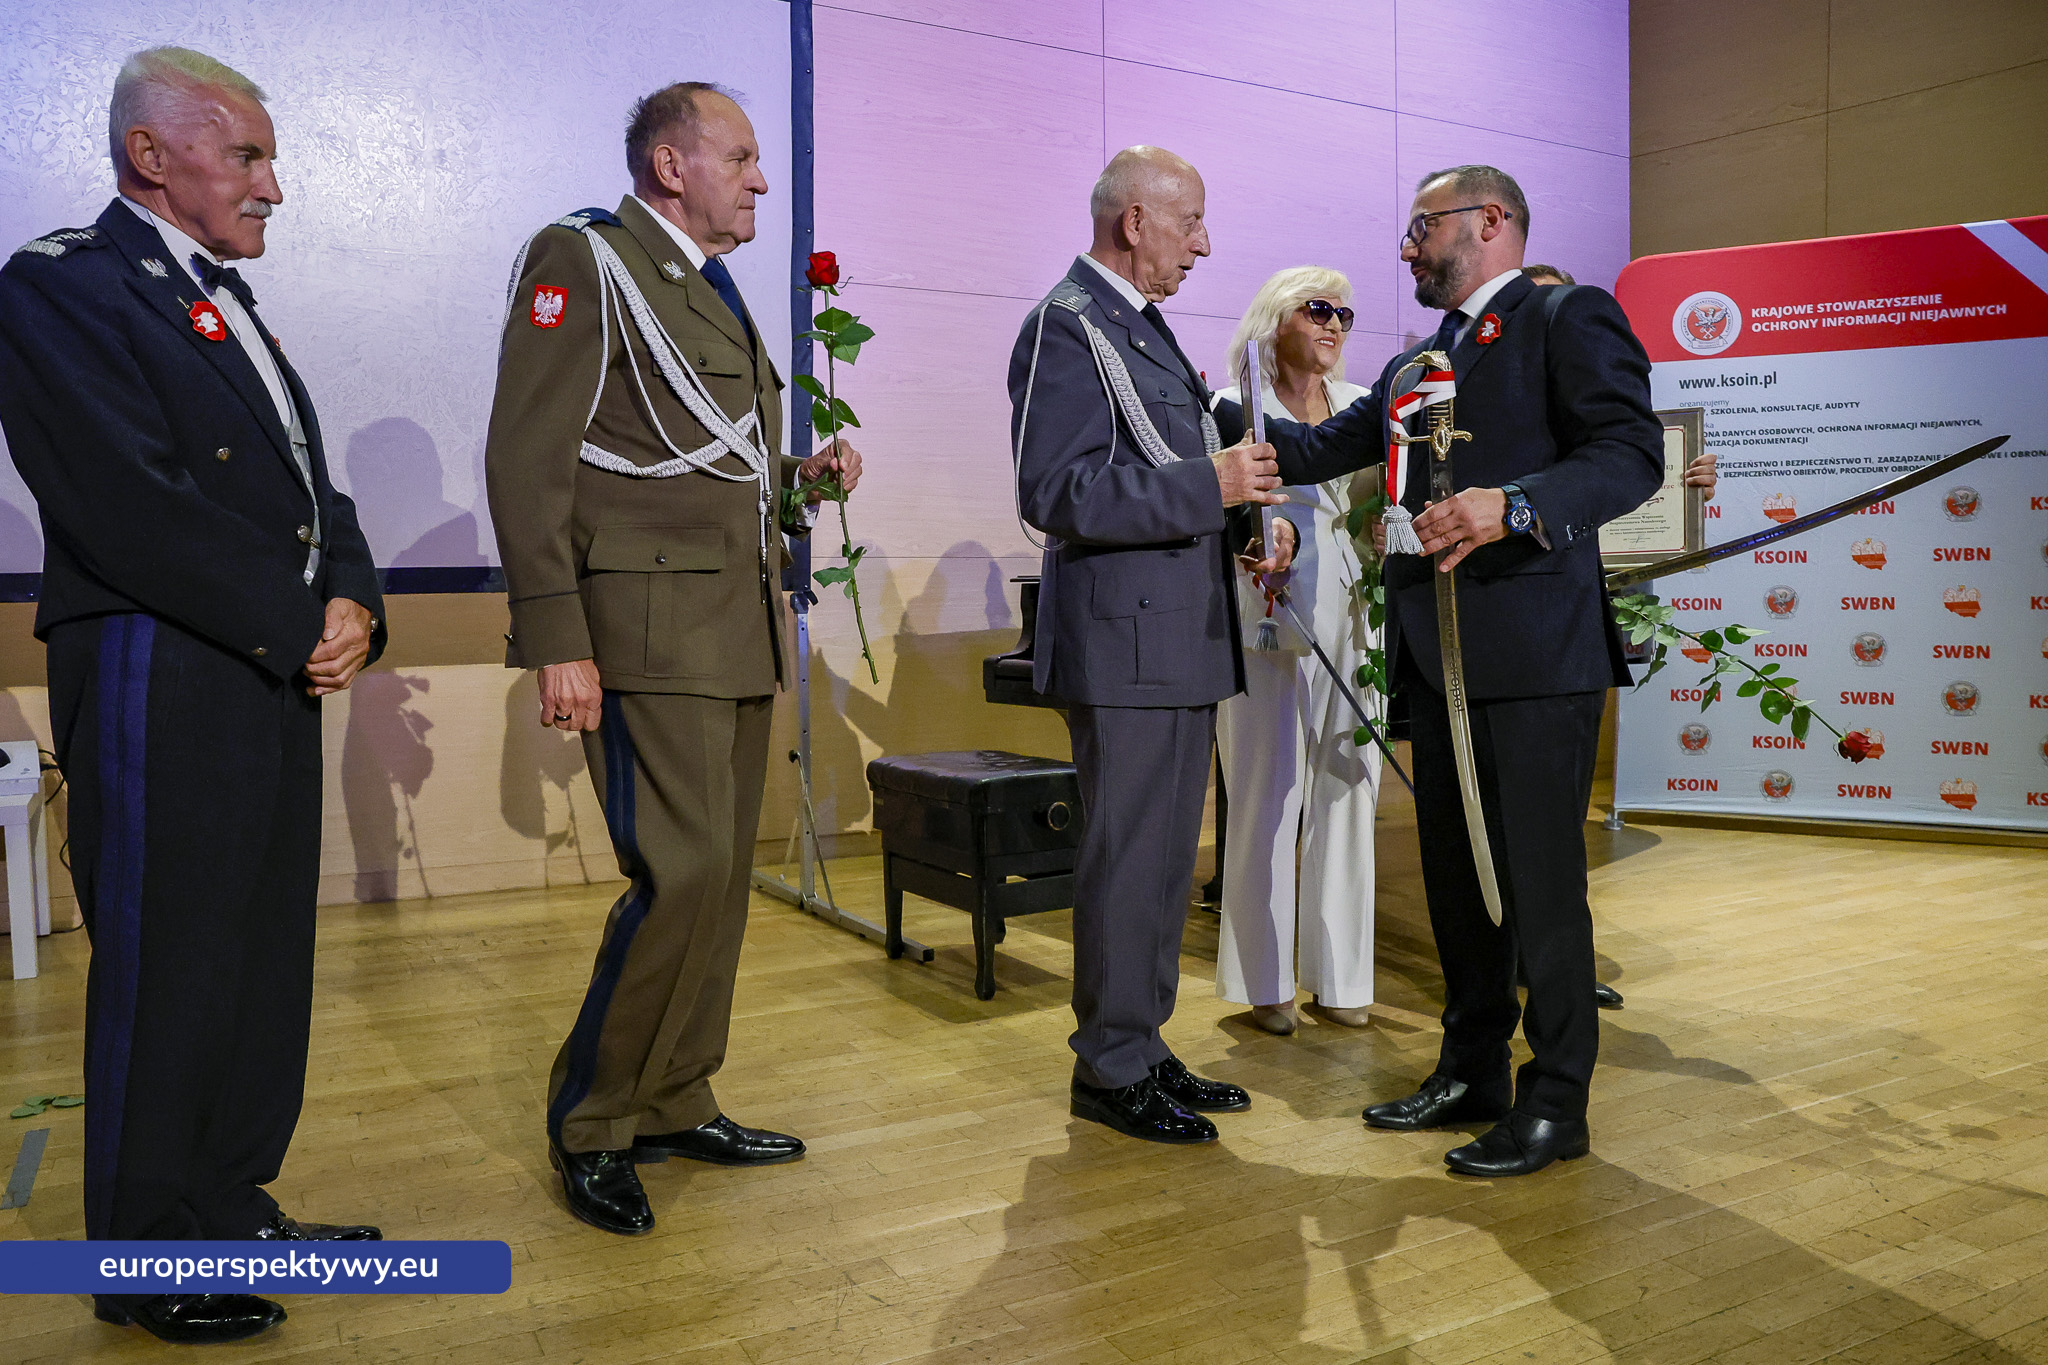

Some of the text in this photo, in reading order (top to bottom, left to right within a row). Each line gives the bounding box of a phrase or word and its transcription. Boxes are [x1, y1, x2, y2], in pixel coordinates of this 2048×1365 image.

[1751, 294, 1942, 319] KRAJOWE STOWARZYSZENIE
[1751, 303, 2007, 333] OCHRONY INFORMACJI NIEJAWNYCH
[1678, 371, 1777, 390] www.ksoin.pl
[1710, 406, 1759, 416] SZKOLENIA,
[1760, 403, 1823, 413] KONSULTACJE,
[1824, 401, 1860, 410] AUDYTY
[1721, 429, 1757, 437] DANYCH
[1758, 427, 1815, 436] OSOBOWYCH,
[1817, 424, 1862, 433] OCHRONA
[1864, 422, 1918, 431] INFORMACJI
[1920, 419, 1983, 430] NIEJAWNYCH,
[1704, 436, 1809, 448] WIZACJA DOKUMENTACJI
[1785, 456, 1861, 467] BEZPIECZEŃSTWO
[1877, 454, 1941, 464] ZARZĄDZANIE
[2010, 449, 2048, 458] OBRON
[1723, 468, 1791, 478] BEZPIECZEŃSTWO
[1793, 466, 1838, 476] OBIEKTÓW,
[1839, 465, 1889, 474] PROCEDURY
[1852, 500, 1895, 515] BN
[1754, 550, 1807, 564] KSOIN
[1933, 547, 1991, 562] SWBN
[1671, 597, 1722, 611] KSOIN
[1840, 596, 1895, 611] SWBN
[1754, 643, 1807, 657] KSOIN
[1932, 644, 1990, 659] SWBN
[1840, 691, 1894, 706] SWBN
[1752, 735, 1806, 750] KSOIN
[1931, 740, 1989, 756] SWBN
[1667, 778, 1718, 792] KSOIN
[1837, 784, 1892, 799] SWBN
